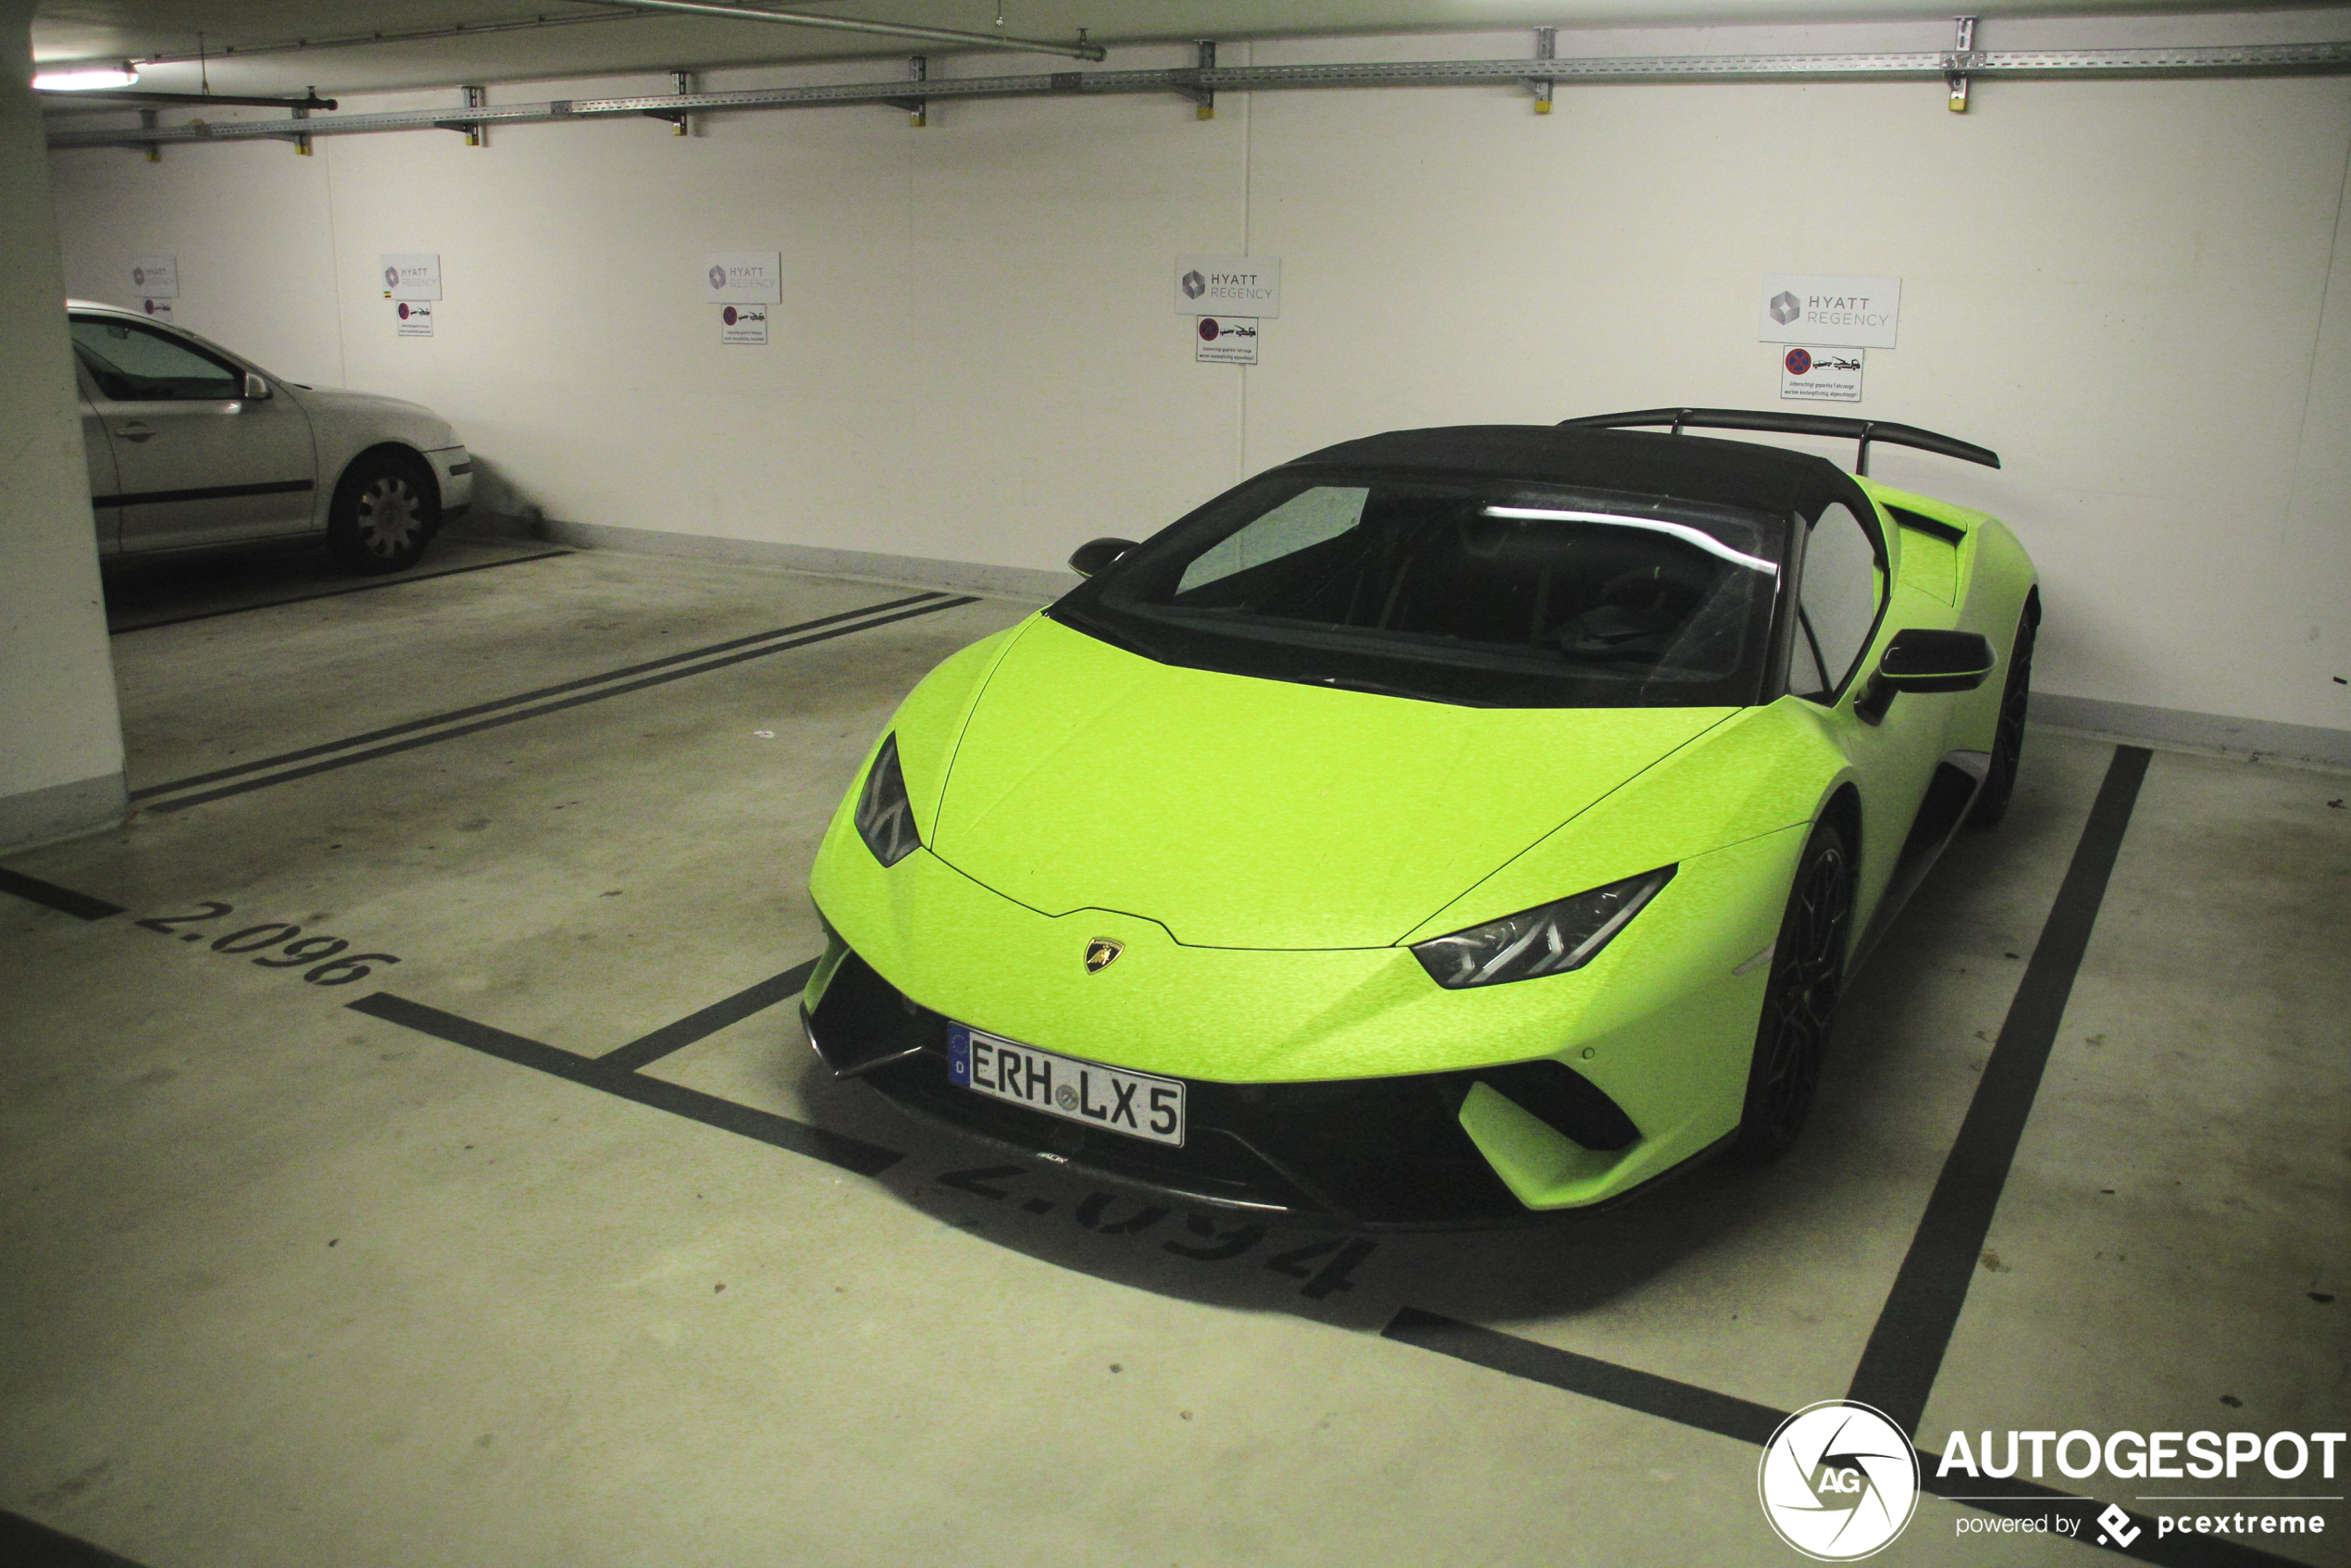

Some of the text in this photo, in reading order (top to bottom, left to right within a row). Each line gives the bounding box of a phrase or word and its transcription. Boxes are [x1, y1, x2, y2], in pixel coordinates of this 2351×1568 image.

[402, 268, 428, 277] HYATT
[729, 268, 764, 277] HYATT
[402, 279, 437, 287] REGENCY
[730, 279, 775, 289] REGENCY
[1211, 273, 1257, 285] HYATT
[1211, 287, 1273, 299] REGENCY
[1809, 295, 1870, 310] HYATT
[1807, 311, 1889, 326] REGENCY
[134, 901, 402, 987] 2.096
[956, 1040, 1177, 1135] D ERH LX 5
